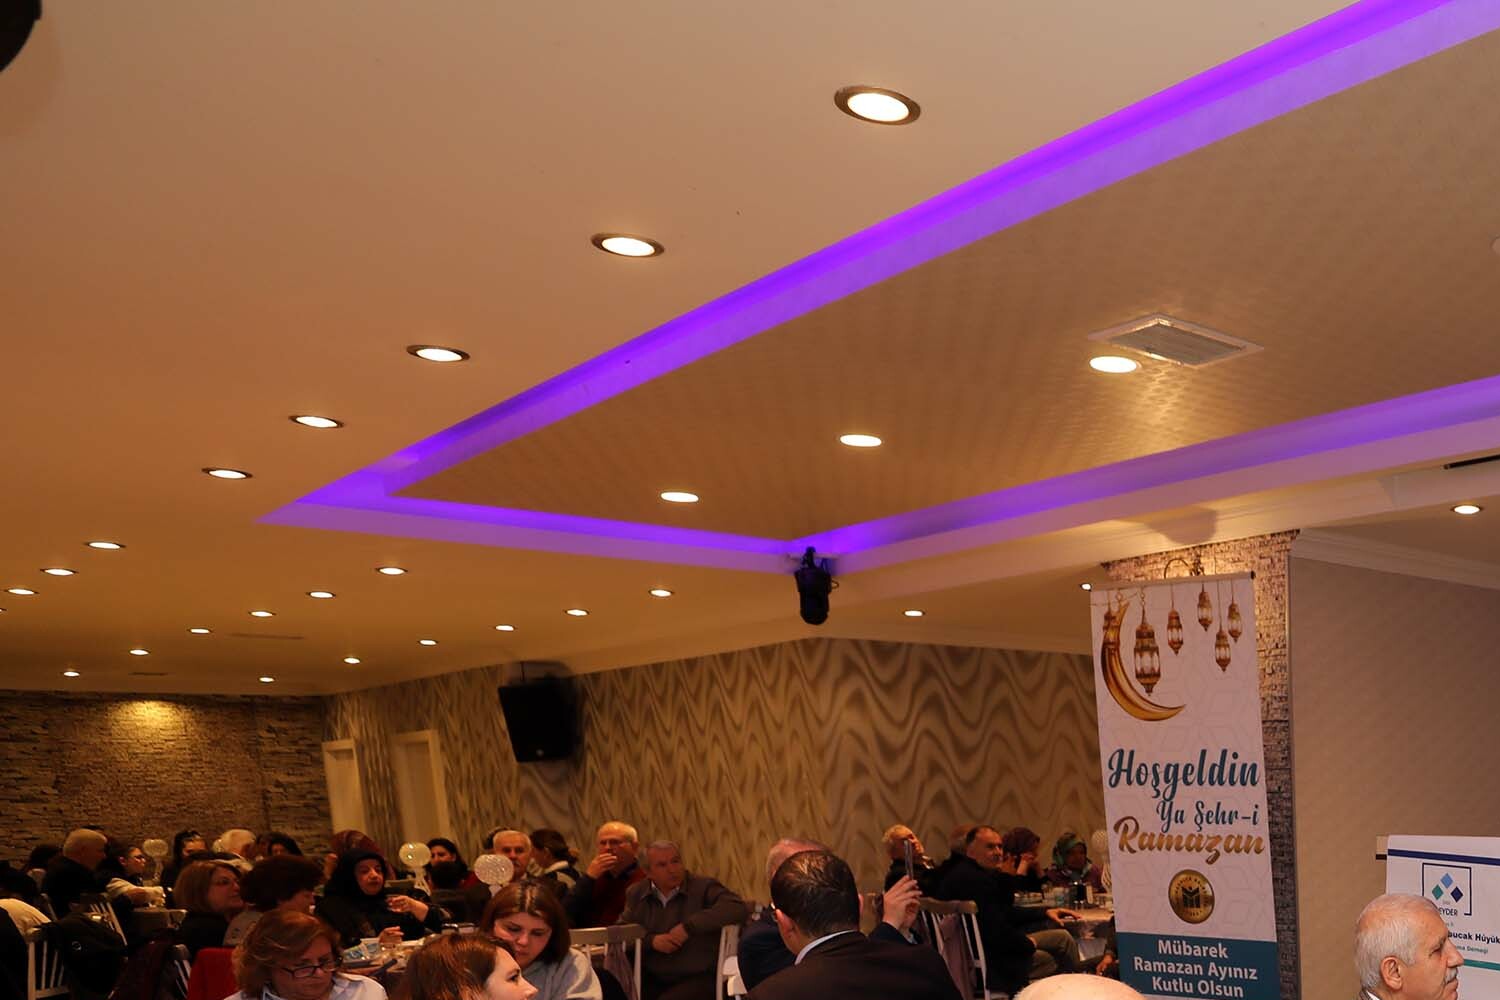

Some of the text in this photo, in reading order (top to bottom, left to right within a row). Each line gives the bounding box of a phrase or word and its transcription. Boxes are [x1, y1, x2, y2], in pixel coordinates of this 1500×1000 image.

[1108, 748, 1260, 801] Hoşgeldin
[1156, 800, 1260, 833] Ya Şehr-i
[1113, 816, 1265, 865] Ramazan
[1438, 906, 1458, 917] EYDER
[1447, 930, 1500, 944] bucak Hüyük
[1158, 939, 1229, 959] Mübarek
[1133, 956, 1258, 981] Ramazan Ayınız
[1152, 976, 1244, 998] Kutlu Olsun
